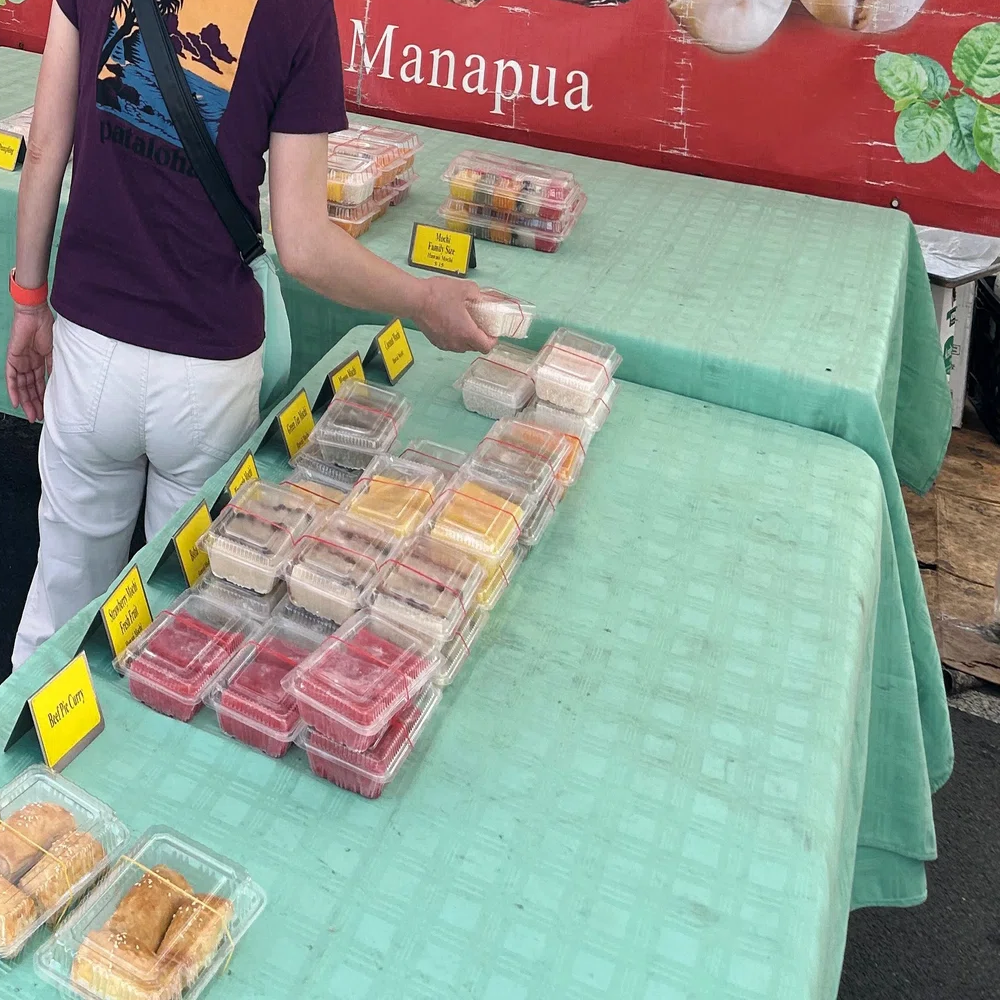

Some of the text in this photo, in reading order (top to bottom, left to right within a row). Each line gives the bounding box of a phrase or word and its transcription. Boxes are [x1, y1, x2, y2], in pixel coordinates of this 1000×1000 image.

[344, 18, 593, 116] Manapua
[428, 241, 455, 256] Family Size
[436, 232, 451, 244] Mochi
[108, 577, 138, 622] Strawberry Mochi
[119, 604, 140, 635] Fresh Fruit
[47, 689, 86, 729] Beef Pie Curry
